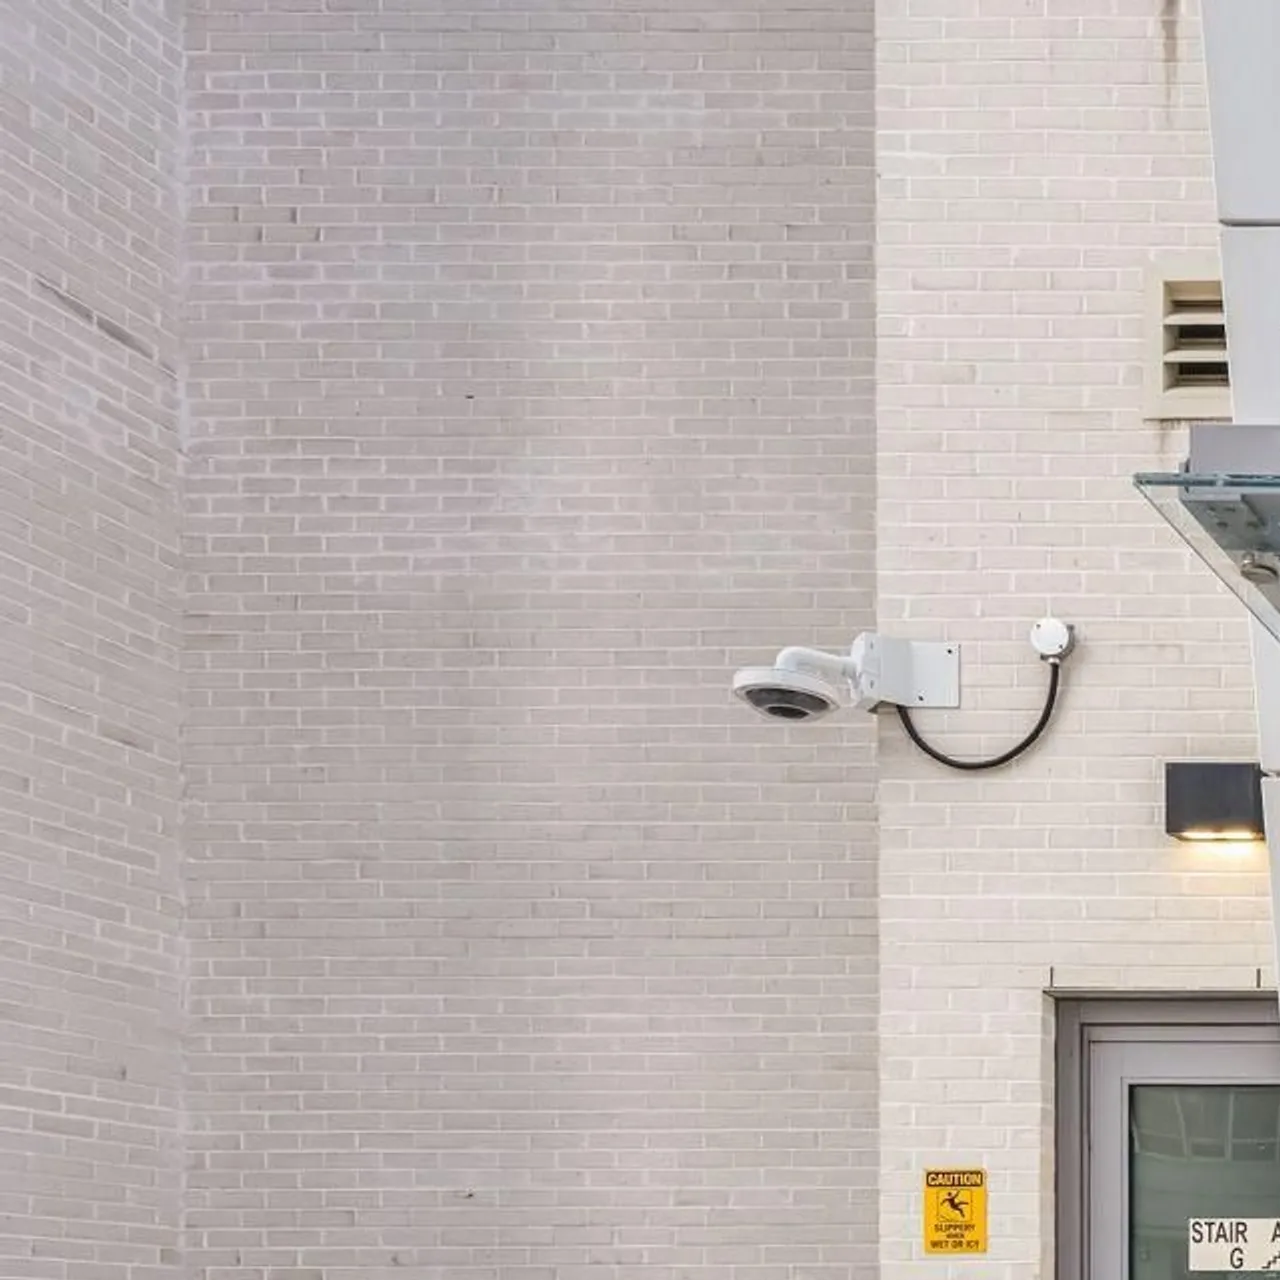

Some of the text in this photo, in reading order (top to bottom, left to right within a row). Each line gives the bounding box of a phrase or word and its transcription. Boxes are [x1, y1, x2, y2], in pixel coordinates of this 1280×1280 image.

[927, 1173, 982, 1187] CAUTION
[934, 1224, 976, 1233] SLIPPERY
[1191, 1220, 1248, 1244] STAIR
[1229, 1246, 1244, 1269] G
